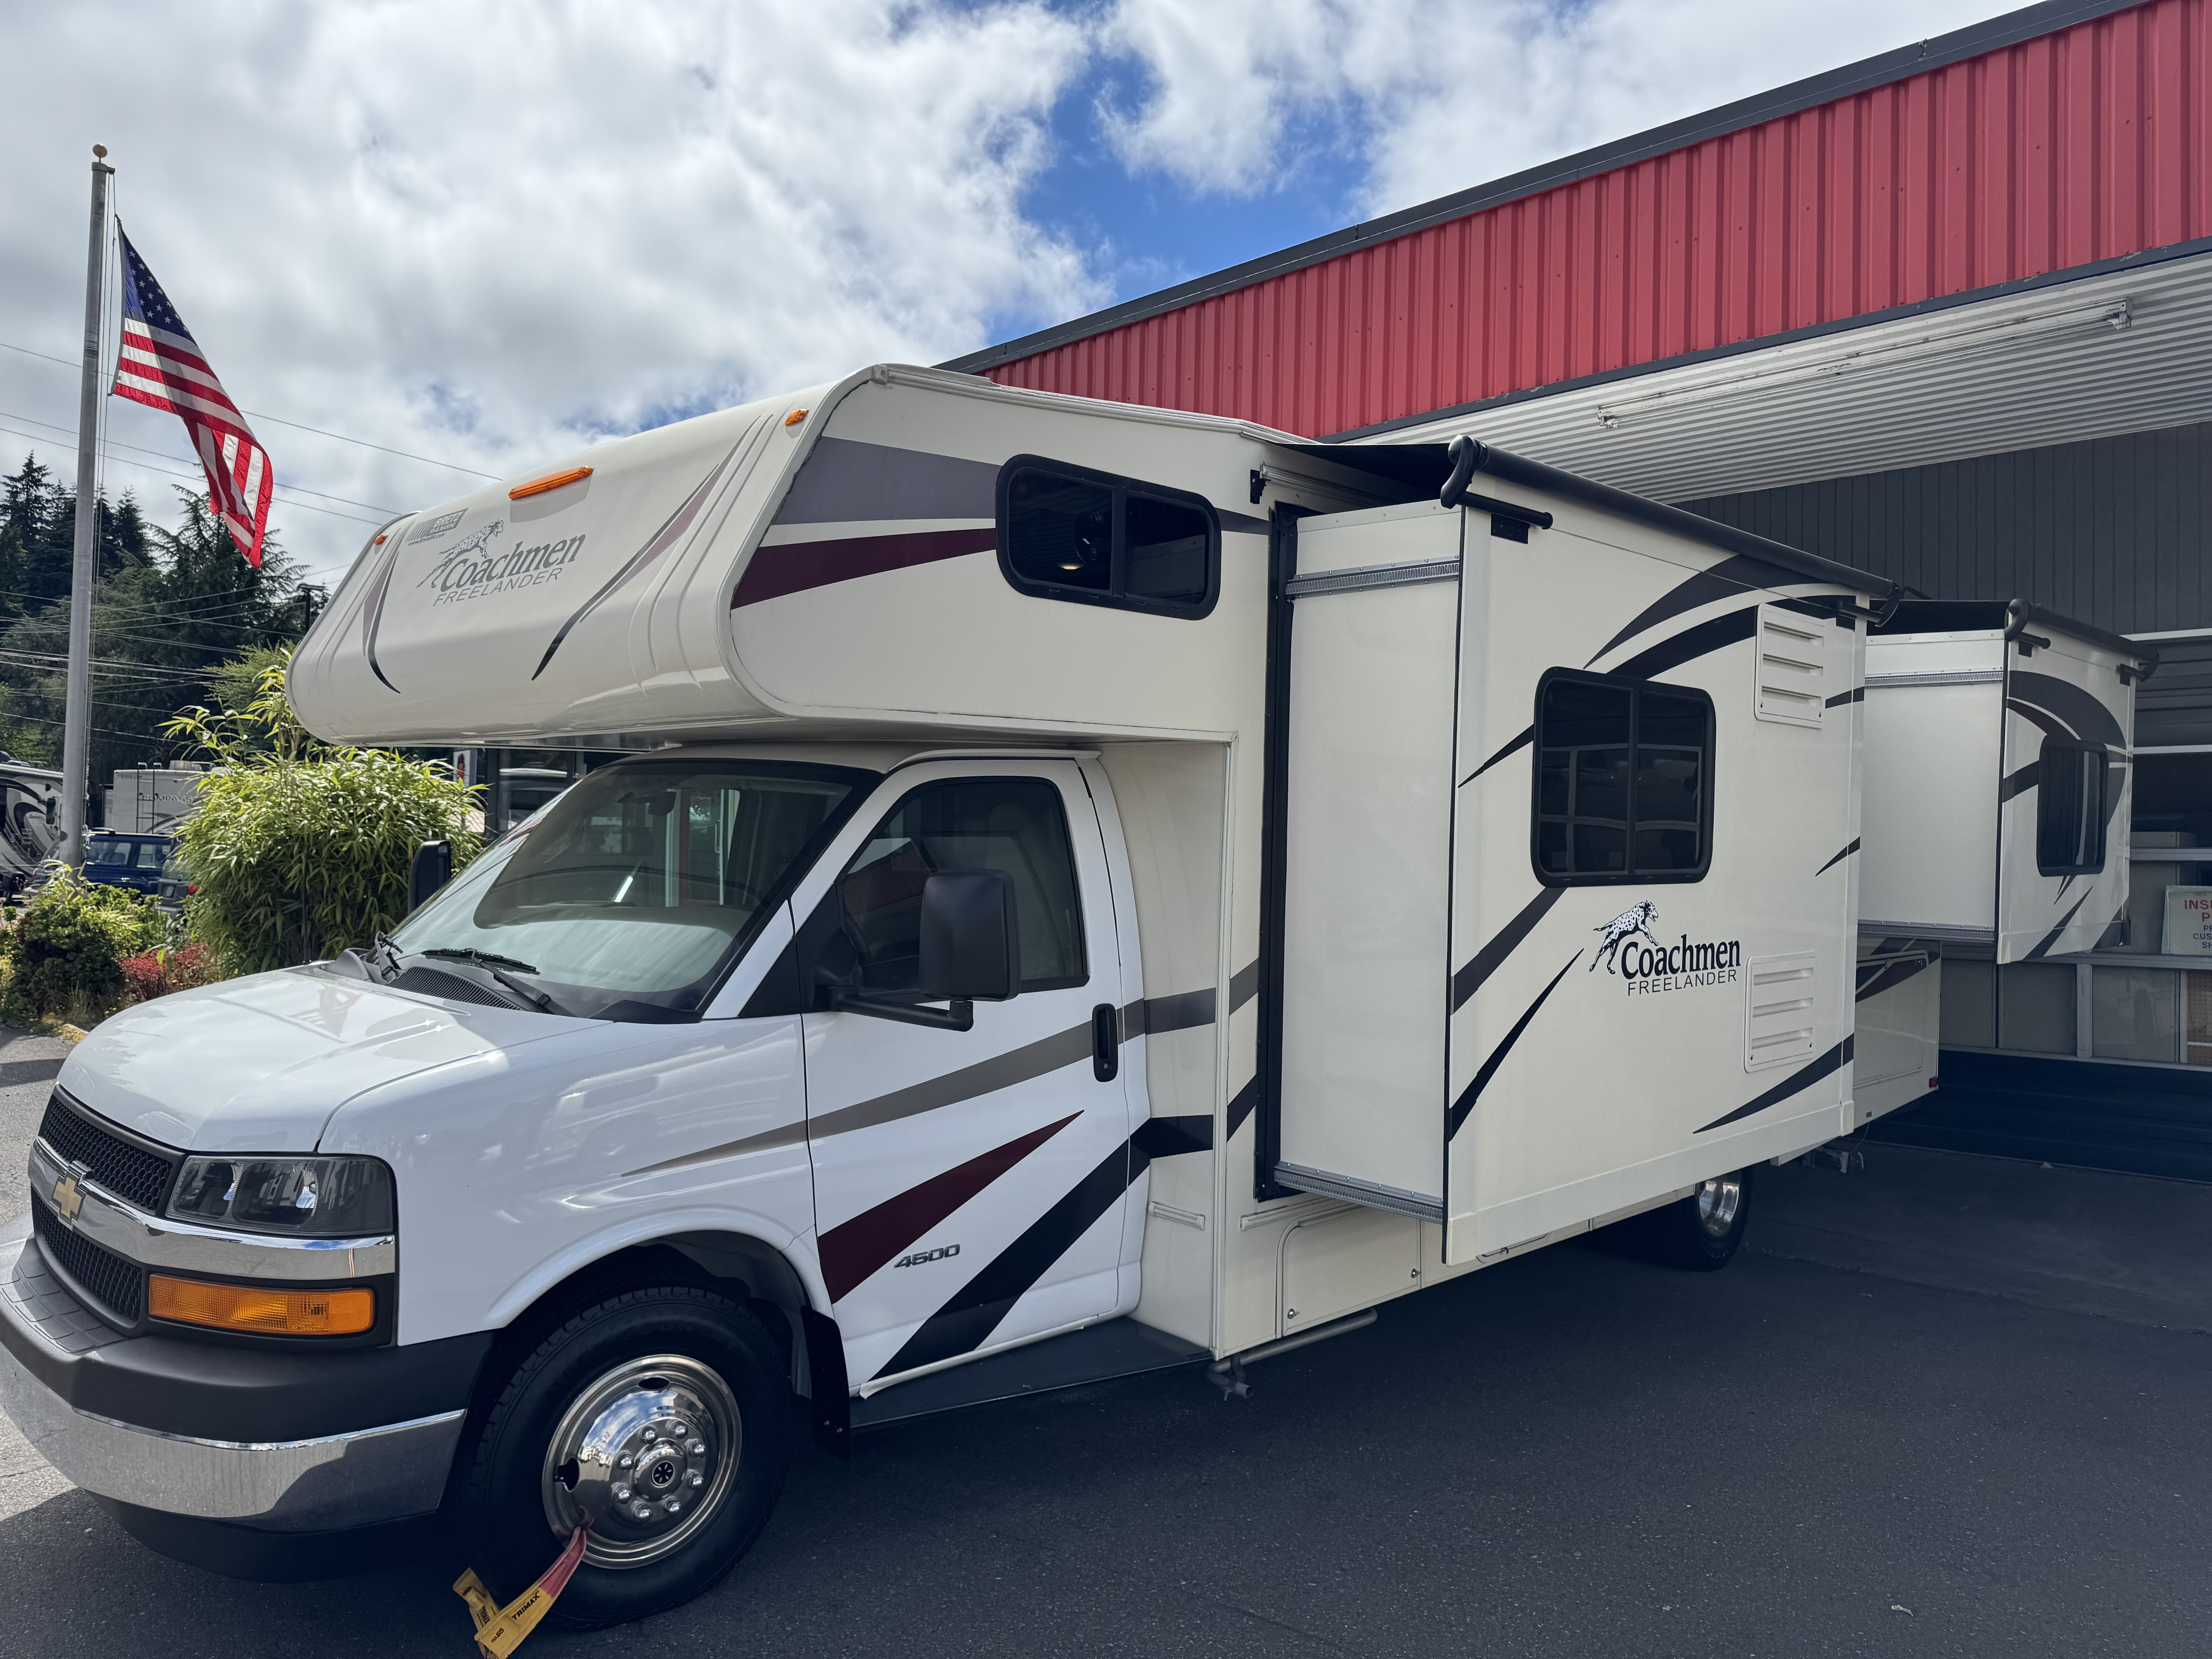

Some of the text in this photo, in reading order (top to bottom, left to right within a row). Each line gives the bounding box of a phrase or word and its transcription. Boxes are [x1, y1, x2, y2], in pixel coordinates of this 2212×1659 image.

[433, 511, 464, 528] BRETZ
[440, 534, 586, 592] Coachmen
[433, 567, 563, 606] FREELANDER
[142, 794, 193, 803] COMPASS
[2184, 900, 2212, 909] INS
[2202, 912, 2212, 922] P
[1621, 933, 1741, 980] Coachmen
[1628, 969, 1736, 996] FREELANDER
[894, 1244, 960, 1268] 4500
[512, 1590, 541, 1620] TRIMAX
